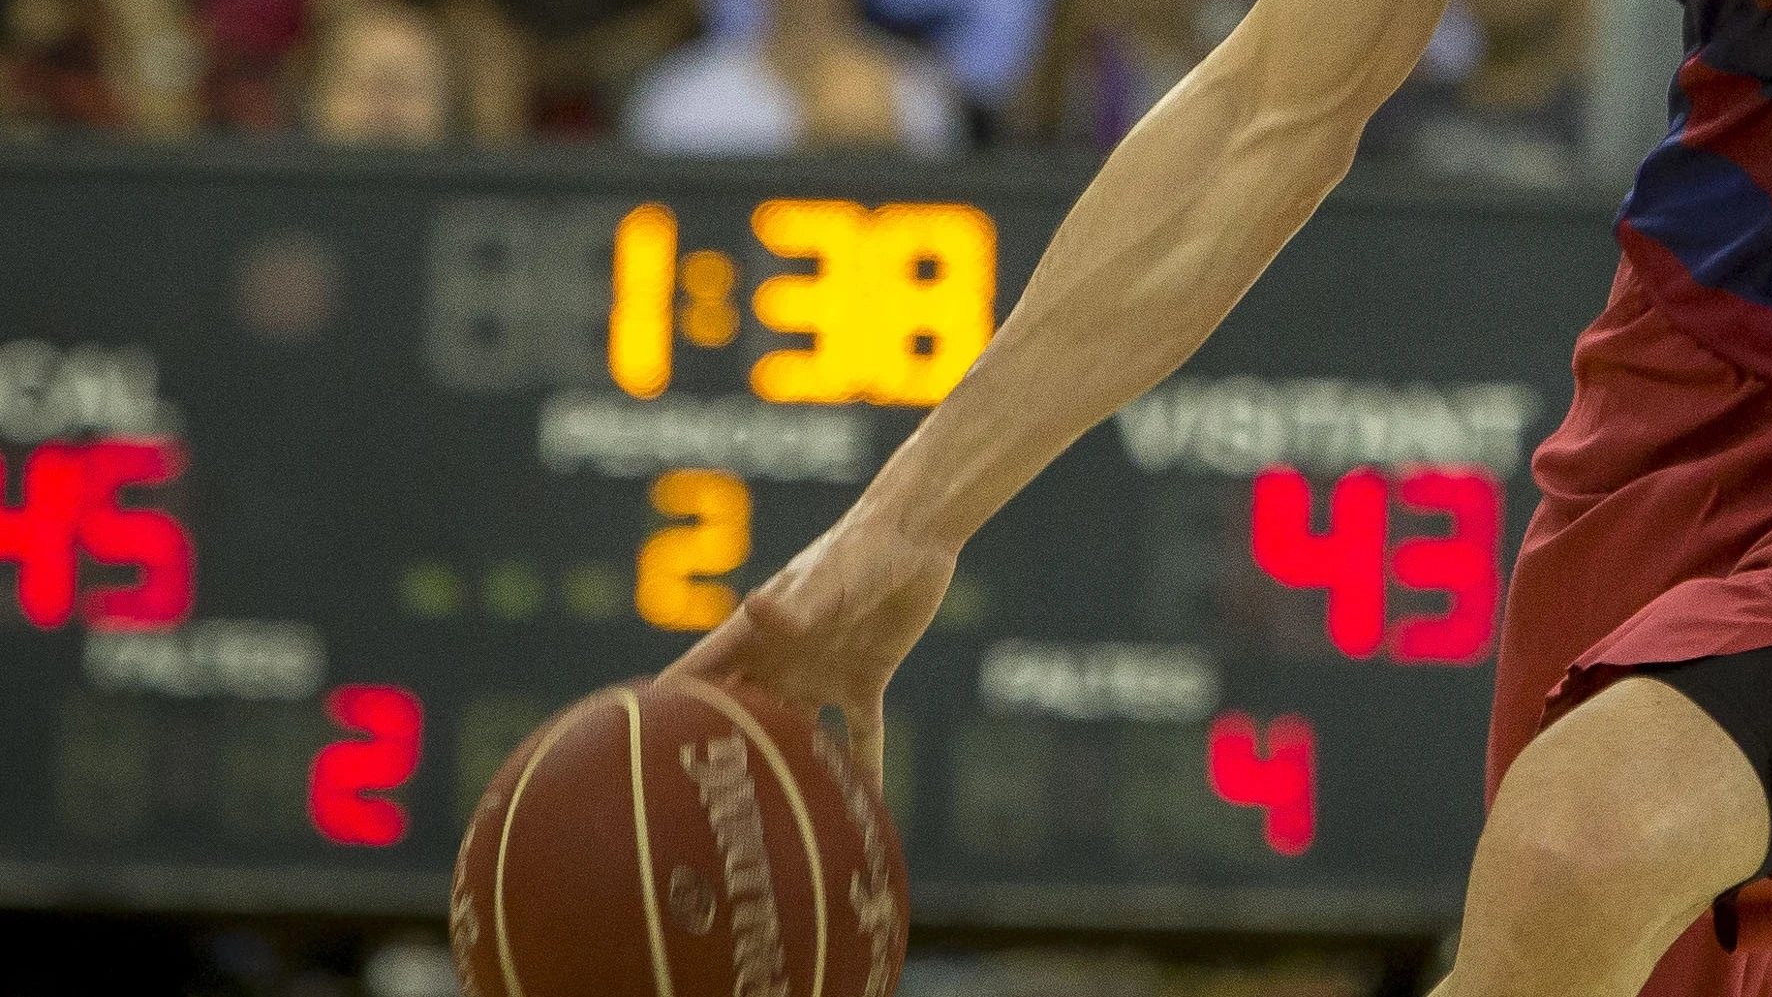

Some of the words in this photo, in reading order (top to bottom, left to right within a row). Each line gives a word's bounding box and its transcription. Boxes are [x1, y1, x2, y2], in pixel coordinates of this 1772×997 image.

[609, 199, 999, 406] 1:38
[0, 438, 192, 632] 45
[637, 468, 753, 631] 2
[1252, 464, 1502, 661] 43
[309, 685, 424, 847] 2
[1208, 711, 1317, 856] 4
